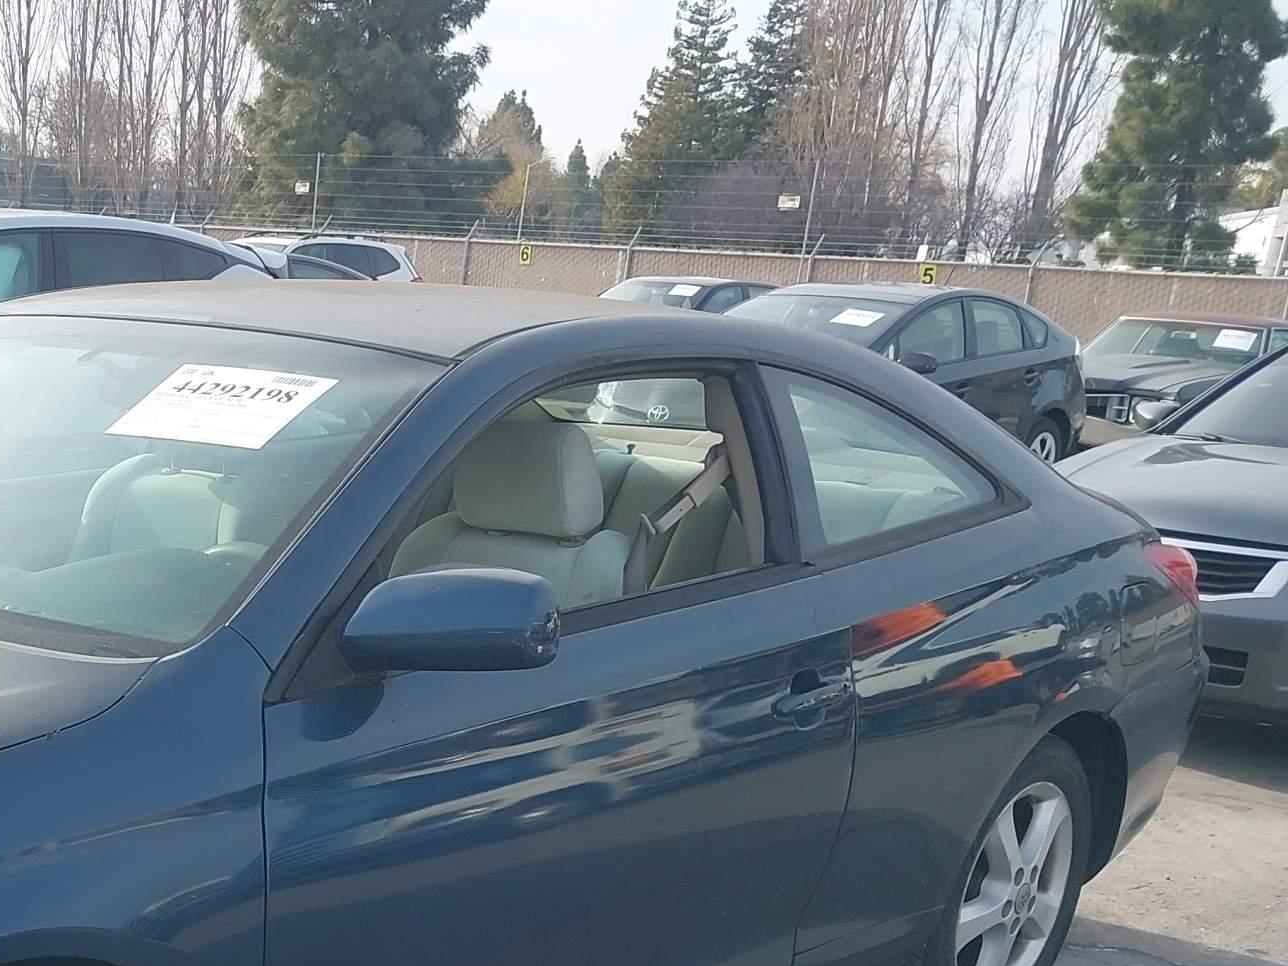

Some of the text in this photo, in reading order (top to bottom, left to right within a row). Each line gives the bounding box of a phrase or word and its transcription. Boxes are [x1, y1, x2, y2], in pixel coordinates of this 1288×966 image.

[521, 246, 530, 262] 6
[922, 267, 934, 284] 5
[172, 380, 300, 404] 44292198
